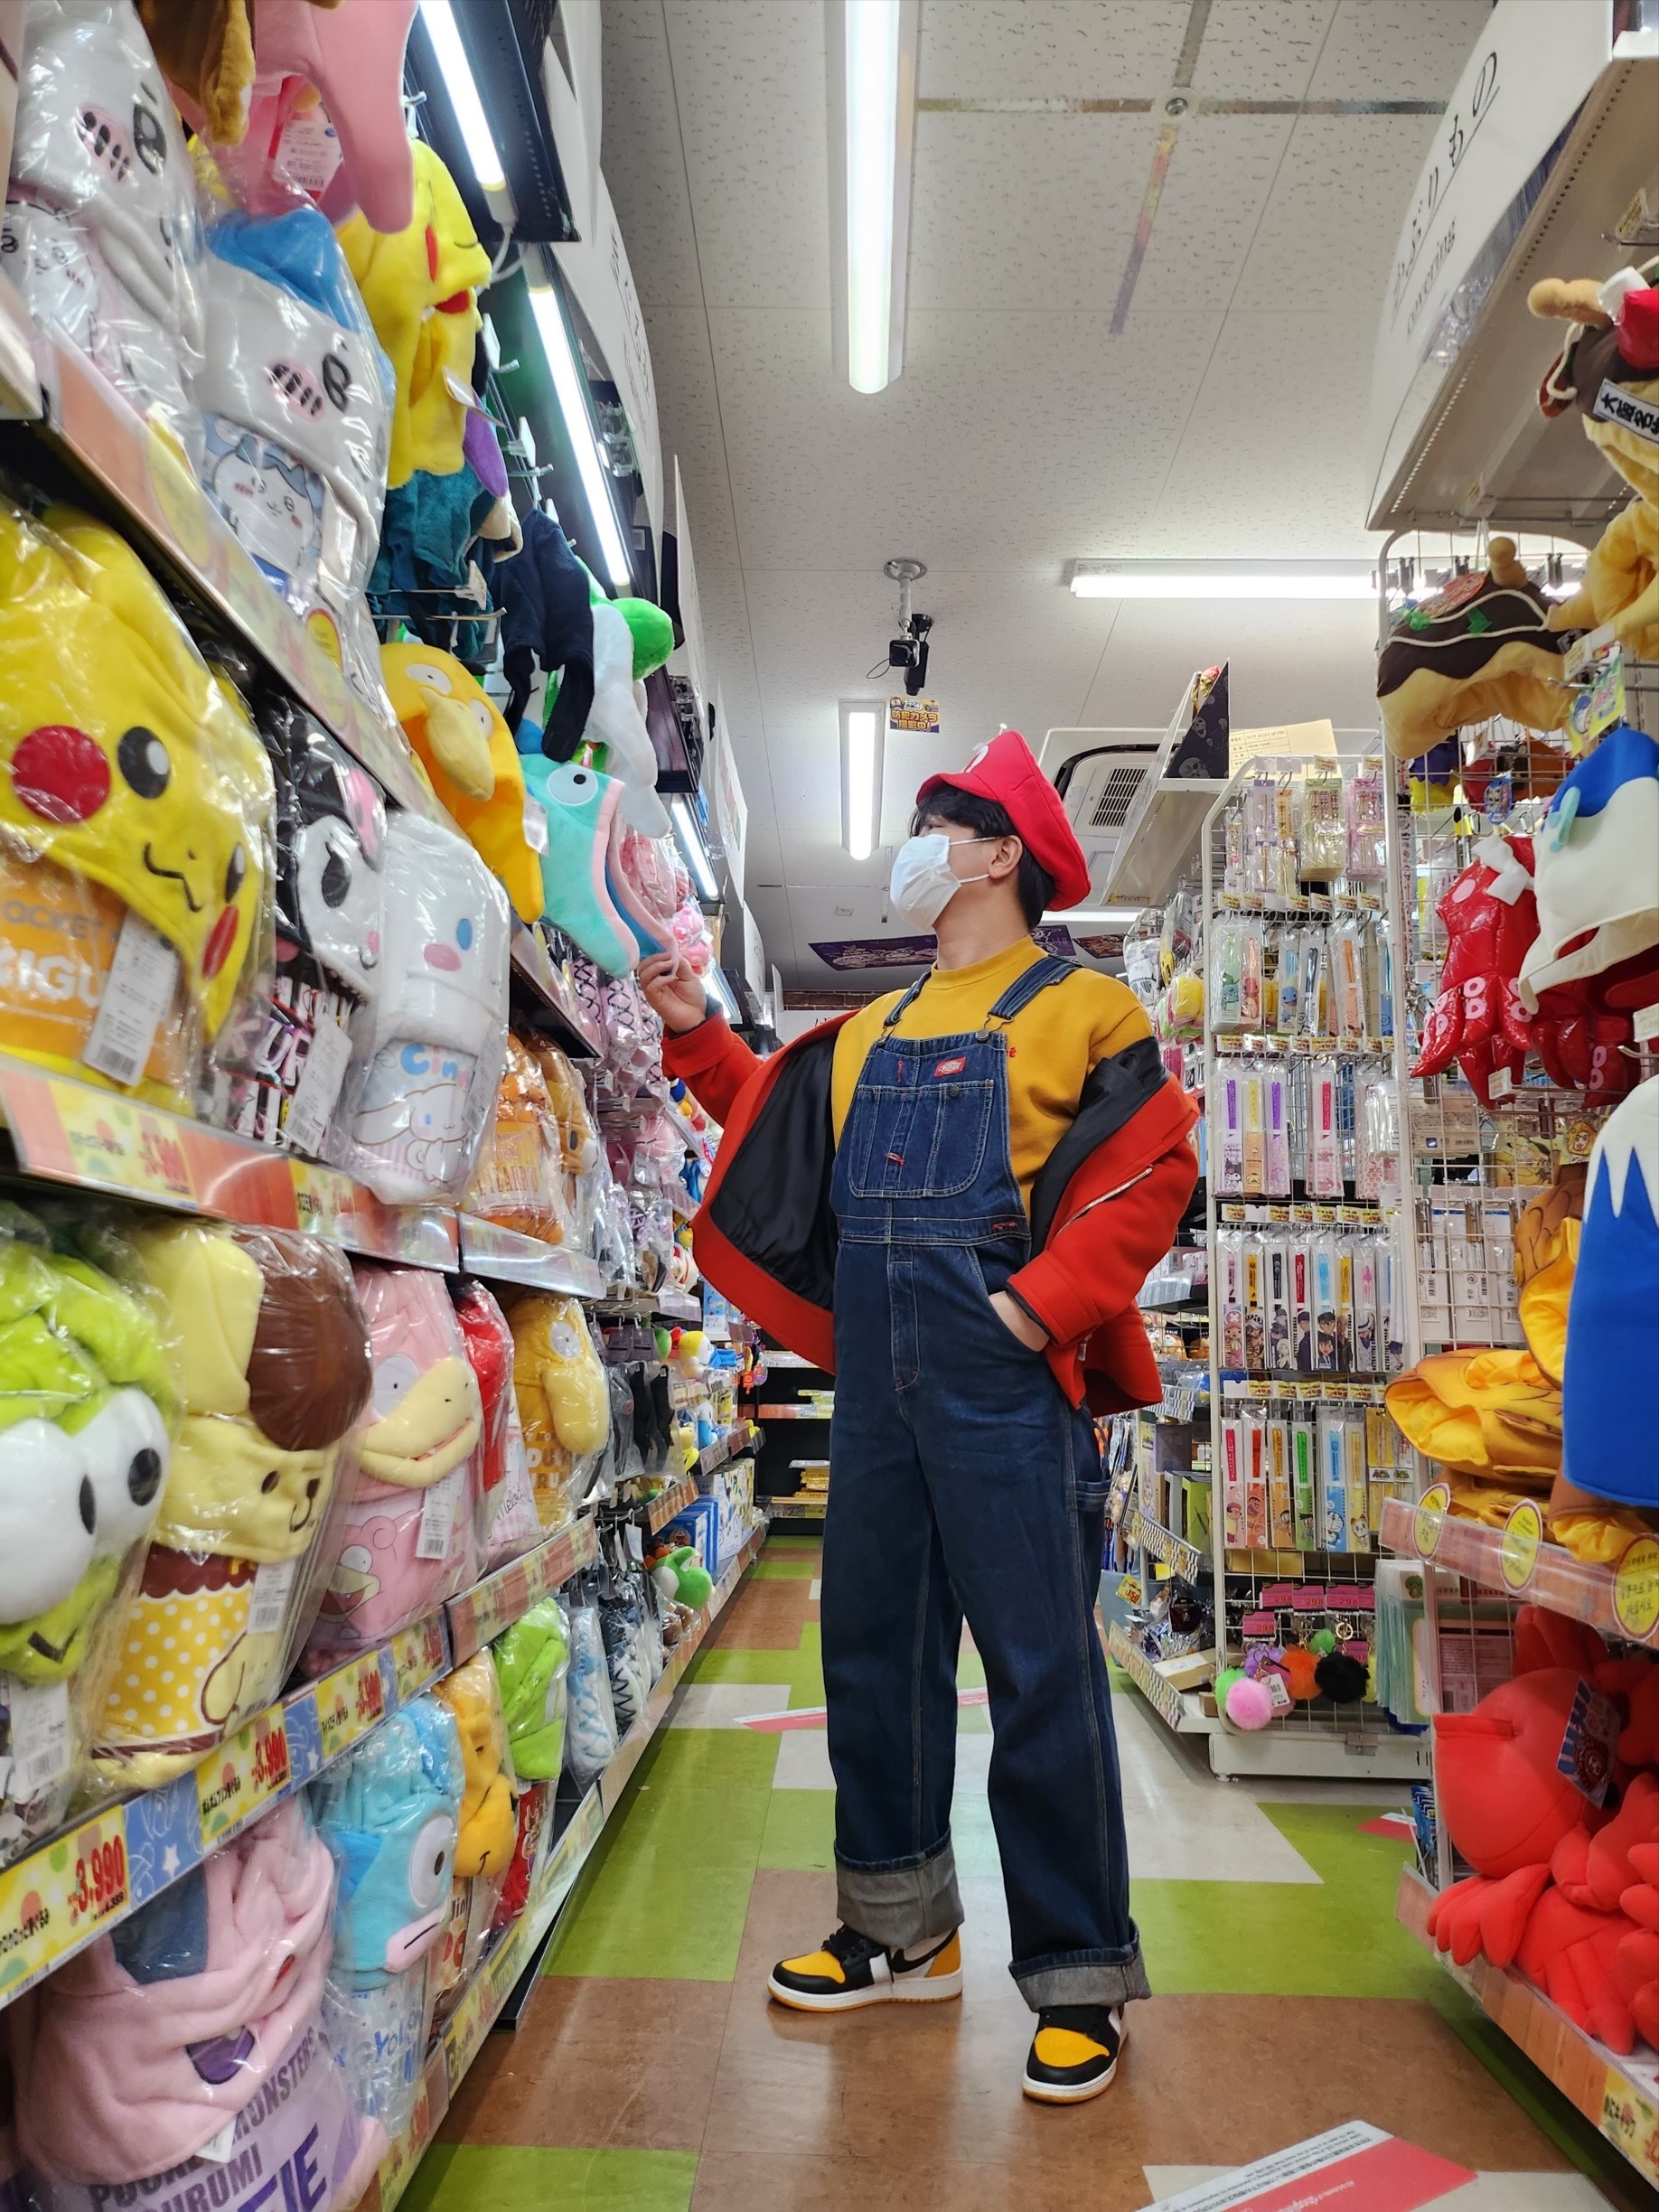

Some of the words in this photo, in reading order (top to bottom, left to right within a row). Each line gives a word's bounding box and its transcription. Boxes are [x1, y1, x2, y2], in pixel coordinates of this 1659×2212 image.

[891, 709, 938, 722] 防犯カメラ
[75, 1834, 125, 1913] 3,990
